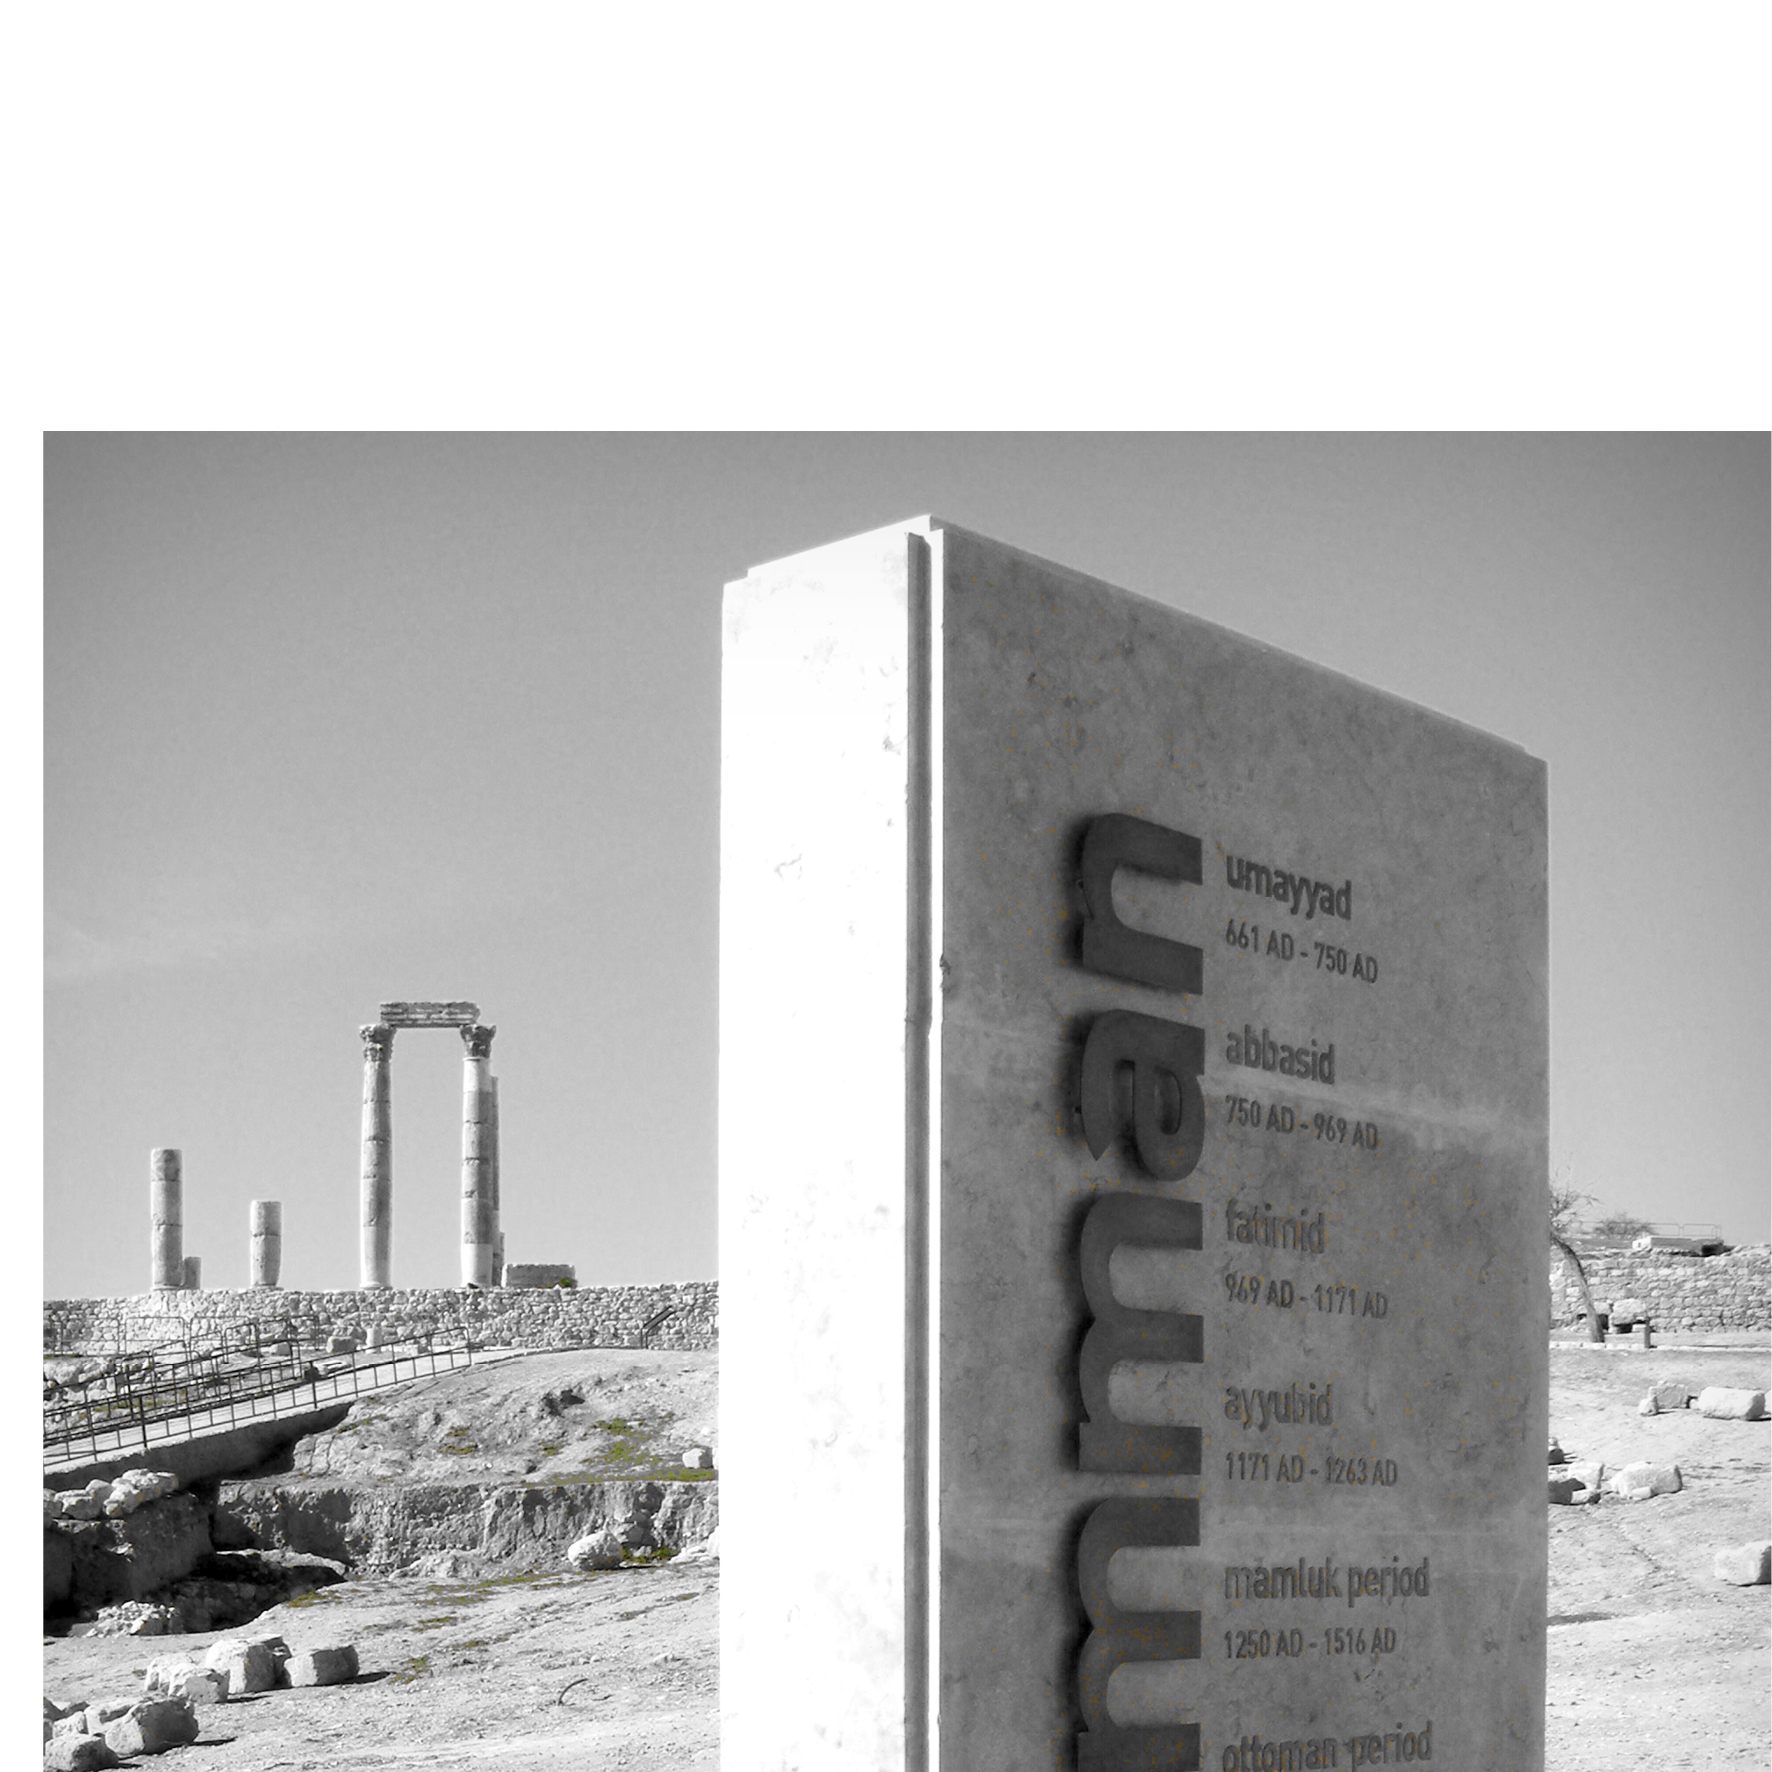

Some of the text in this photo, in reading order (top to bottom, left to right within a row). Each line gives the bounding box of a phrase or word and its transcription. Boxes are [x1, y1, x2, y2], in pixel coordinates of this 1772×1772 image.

[1226, 855, 1352, 920] umayyad
[1226, 920, 1378, 984] 661 AD 750 AD
[1226, 1024, 1335, 1084] abbasid
[1227, 1096, 1378, 1151] 750 AD 969 AD
[1227, 1198, 1325, 1254] fatimid
[1225, 1273, 1388, 1319] 969 AD 1171 AD
[1225, 1383, 1333, 1431] ayyubid
[1226, 1452, 1397, 1486] 1171 AD 1263 AD
[1225, 1556, 1429, 1607] mamluk period
[1226, 1627, 1396, 1659] 1250 AD 1516 AD
